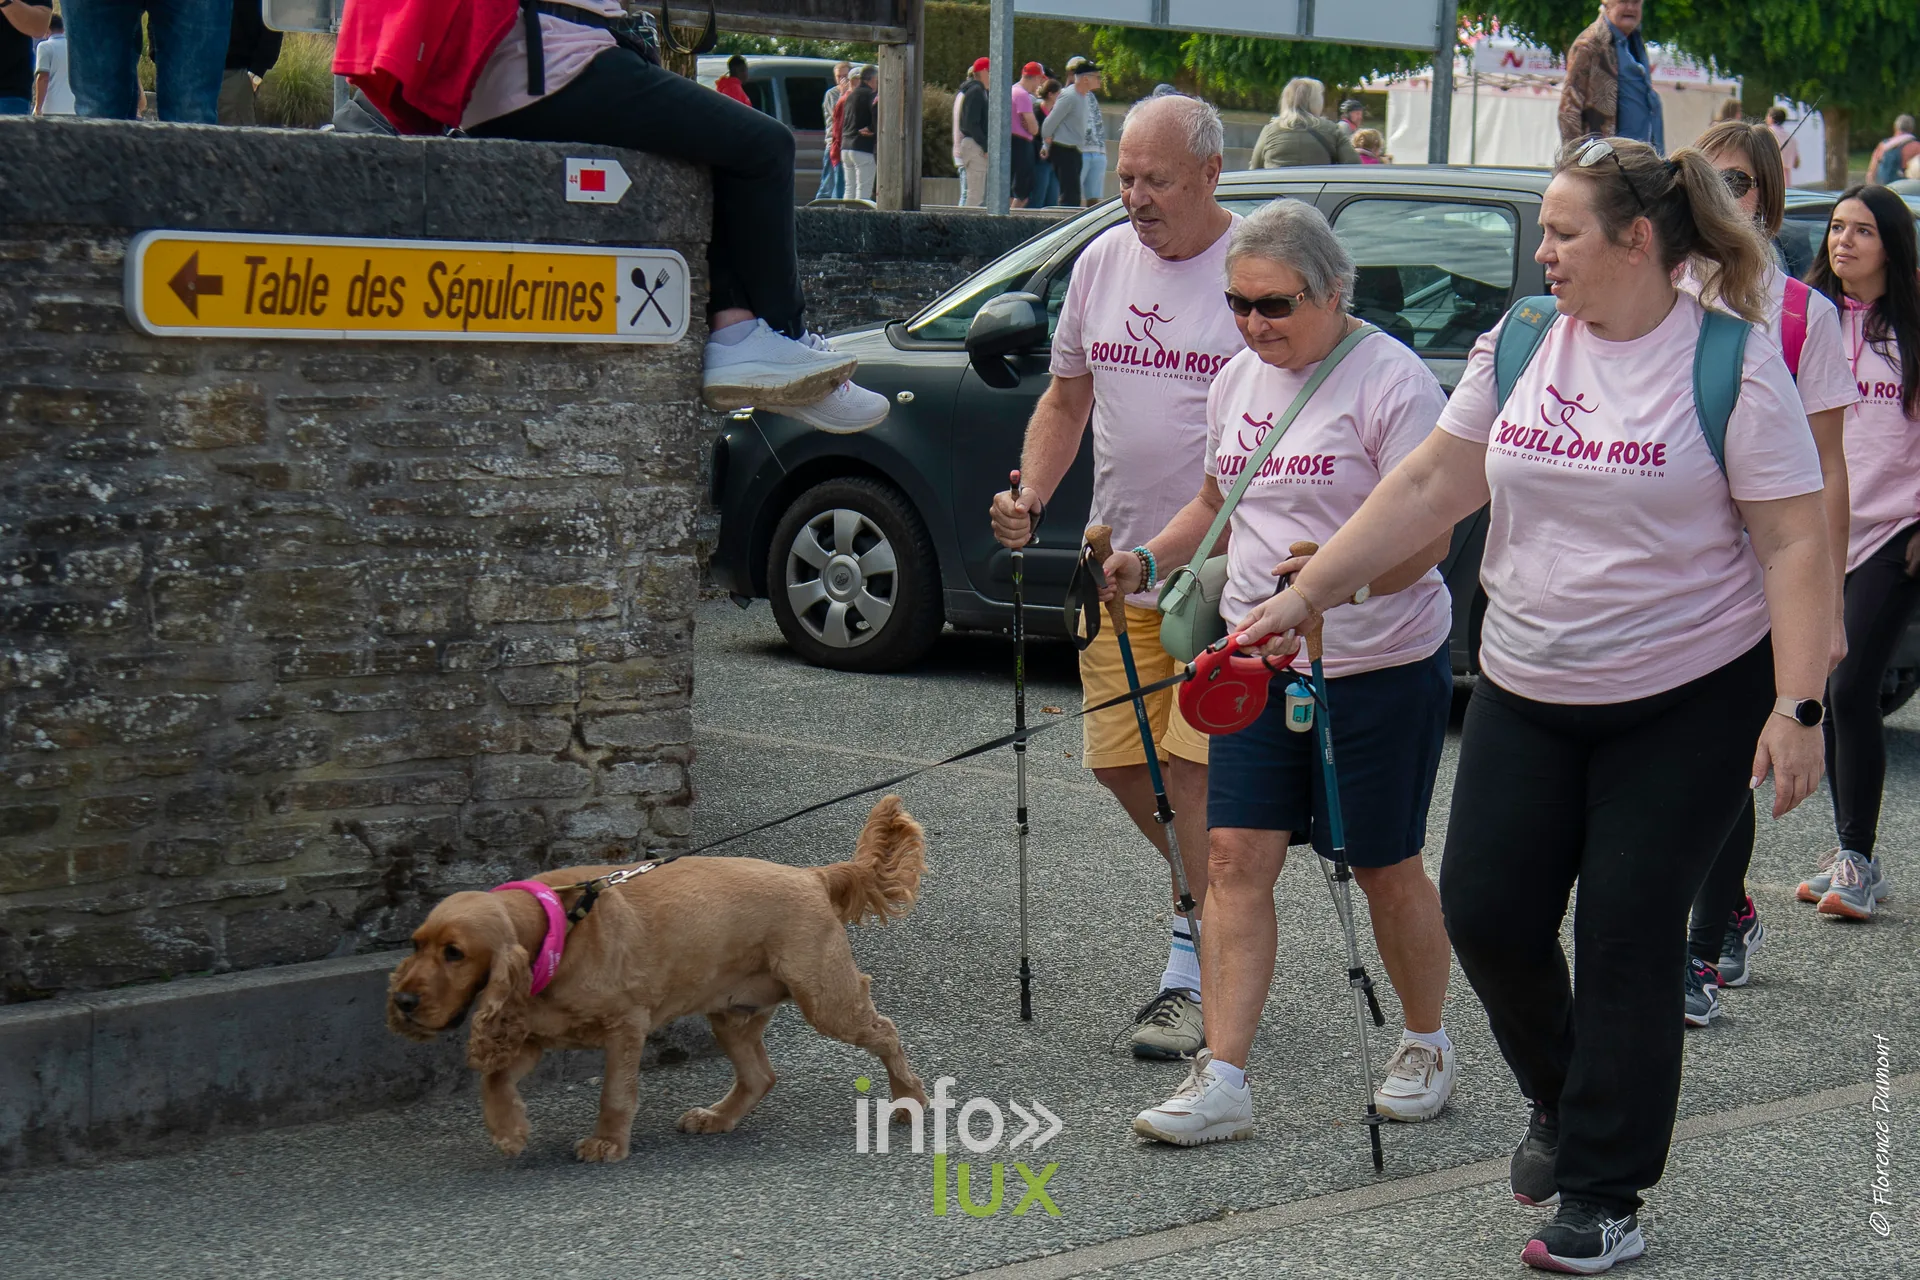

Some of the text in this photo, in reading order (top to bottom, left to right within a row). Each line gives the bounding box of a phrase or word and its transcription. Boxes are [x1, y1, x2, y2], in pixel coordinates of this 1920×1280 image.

[244, 255, 605, 333] Table des Sépulcrines
[1091, 341, 1180, 370] BOUILLON
[1120, 367, 1149, 376] CONTRE
[1163, 372, 1194, 381] CANCER
[1874, 381, 1905, 400] ROS
[1285, 454, 1336, 476] ROSE
[1521, 453, 1558, 466] CONTRE
[1562, 460, 1573, 468] LE
[1577, 463, 1617, 474] CANCER
[1640, 470, 1666, 478] SEIN
[1606, 441, 1667, 467] ROSE
